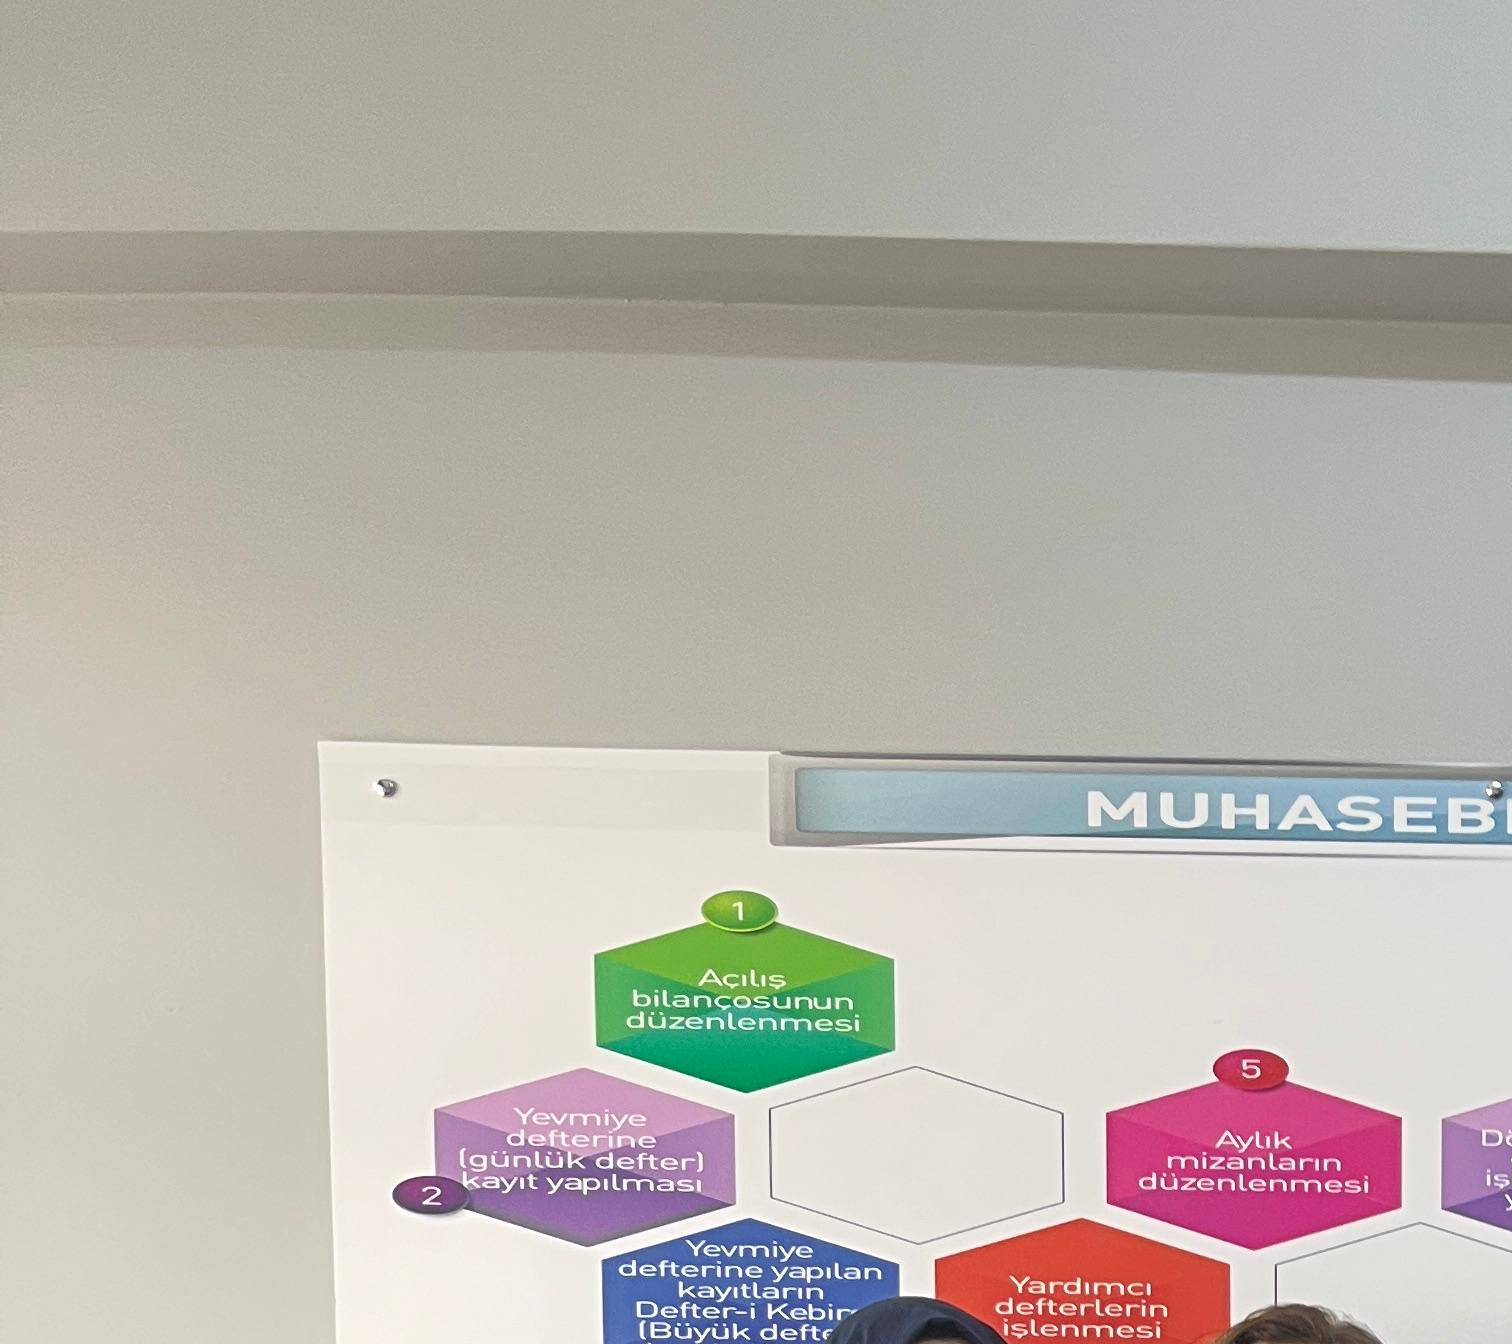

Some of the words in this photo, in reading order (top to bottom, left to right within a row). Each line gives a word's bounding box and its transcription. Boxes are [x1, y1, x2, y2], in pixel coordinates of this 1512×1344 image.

[731, 900, 745, 921] 1
[698, 968, 787, 990] Açılış
[631, 989, 855, 1014] bilançosunun
[625, 1011, 862, 1033] düzenlenmesi
[1240, 1059, 1262, 1080] 5
[513, 1107, 647, 1130] Yevmiye
[505, 1128, 657, 1149] defterine
[1214, 1129, 1293, 1151] Aylık
[458, 1149, 587, 1172] (günlük
[594, 1150, 705, 1173] defter)
[1166, 1151, 1343, 1172] mizanların
[461, 1171, 539, 1195] kayıt
[546, 1172, 703, 1196] yapılması
[1137, 1171, 1371, 1195] düzenlenmesi
[421, 1187, 442, 1206] 2
[685, 1239, 814, 1263] Yevmiye
[618, 1260, 763, 1278] defterine
[772, 1263, 883, 1284] yapılan
[678, 1281, 825, 1302] kayıtların
[1008, 1275, 1153, 1296] Yardımcı
[636, 1301, 756, 1320] Defter-i
[767, 1303, 859, 1321] Kebir
[994, 1297, 1169, 1318] defterlerin
[638, 1321, 751, 1344] (Büyük
[1002, 1318, 1162, 1340] işlenmesi
